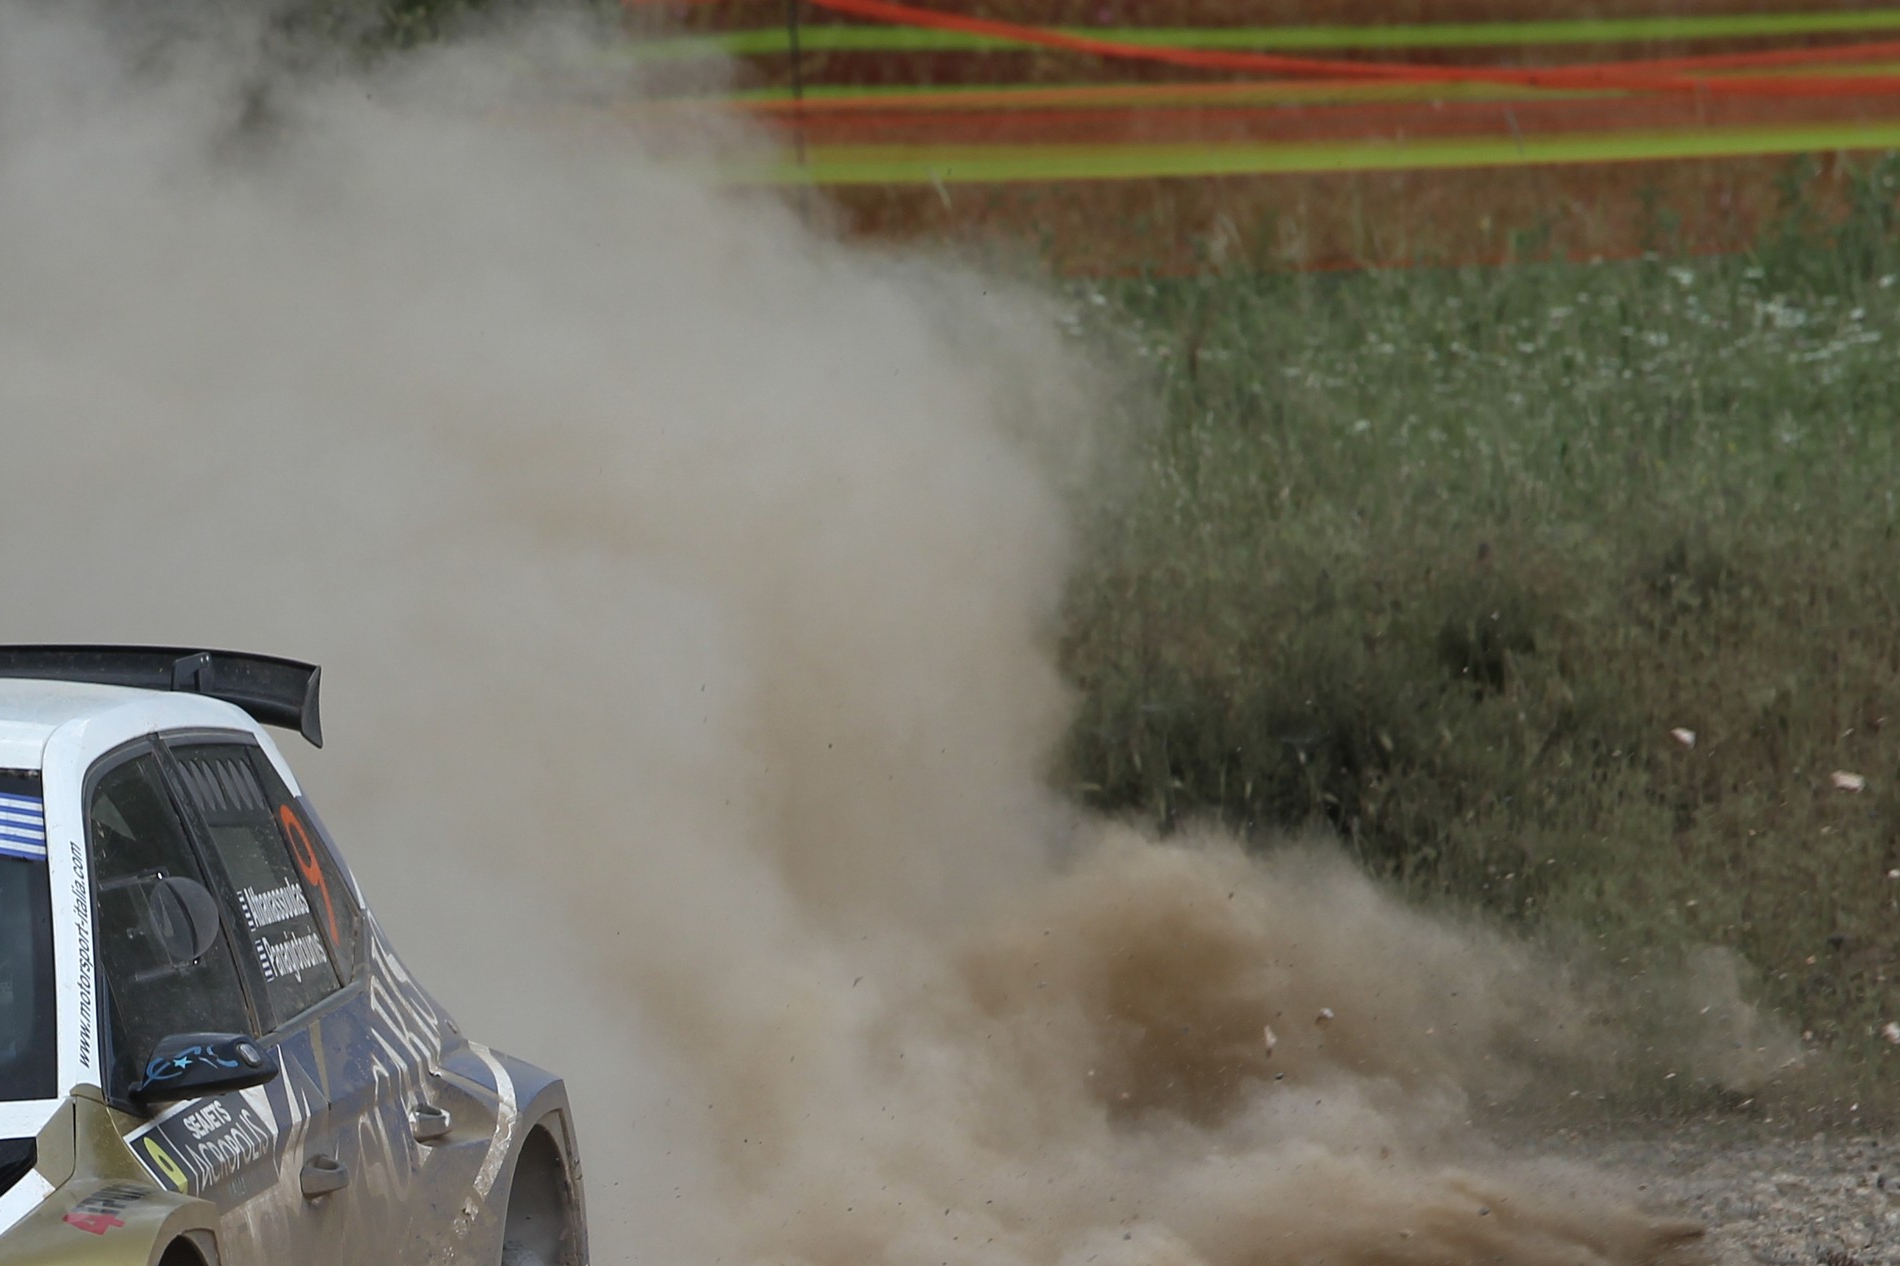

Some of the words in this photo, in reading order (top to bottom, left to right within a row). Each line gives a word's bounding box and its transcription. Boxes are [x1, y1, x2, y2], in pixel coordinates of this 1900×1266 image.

[280, 804, 340, 948] 9
[70, 841, 93, 1069] www.motorsport-italia.com
[183, 1100, 232, 1140] SEAJETS
[185, 1108, 269, 1192] ACROPOLIS
